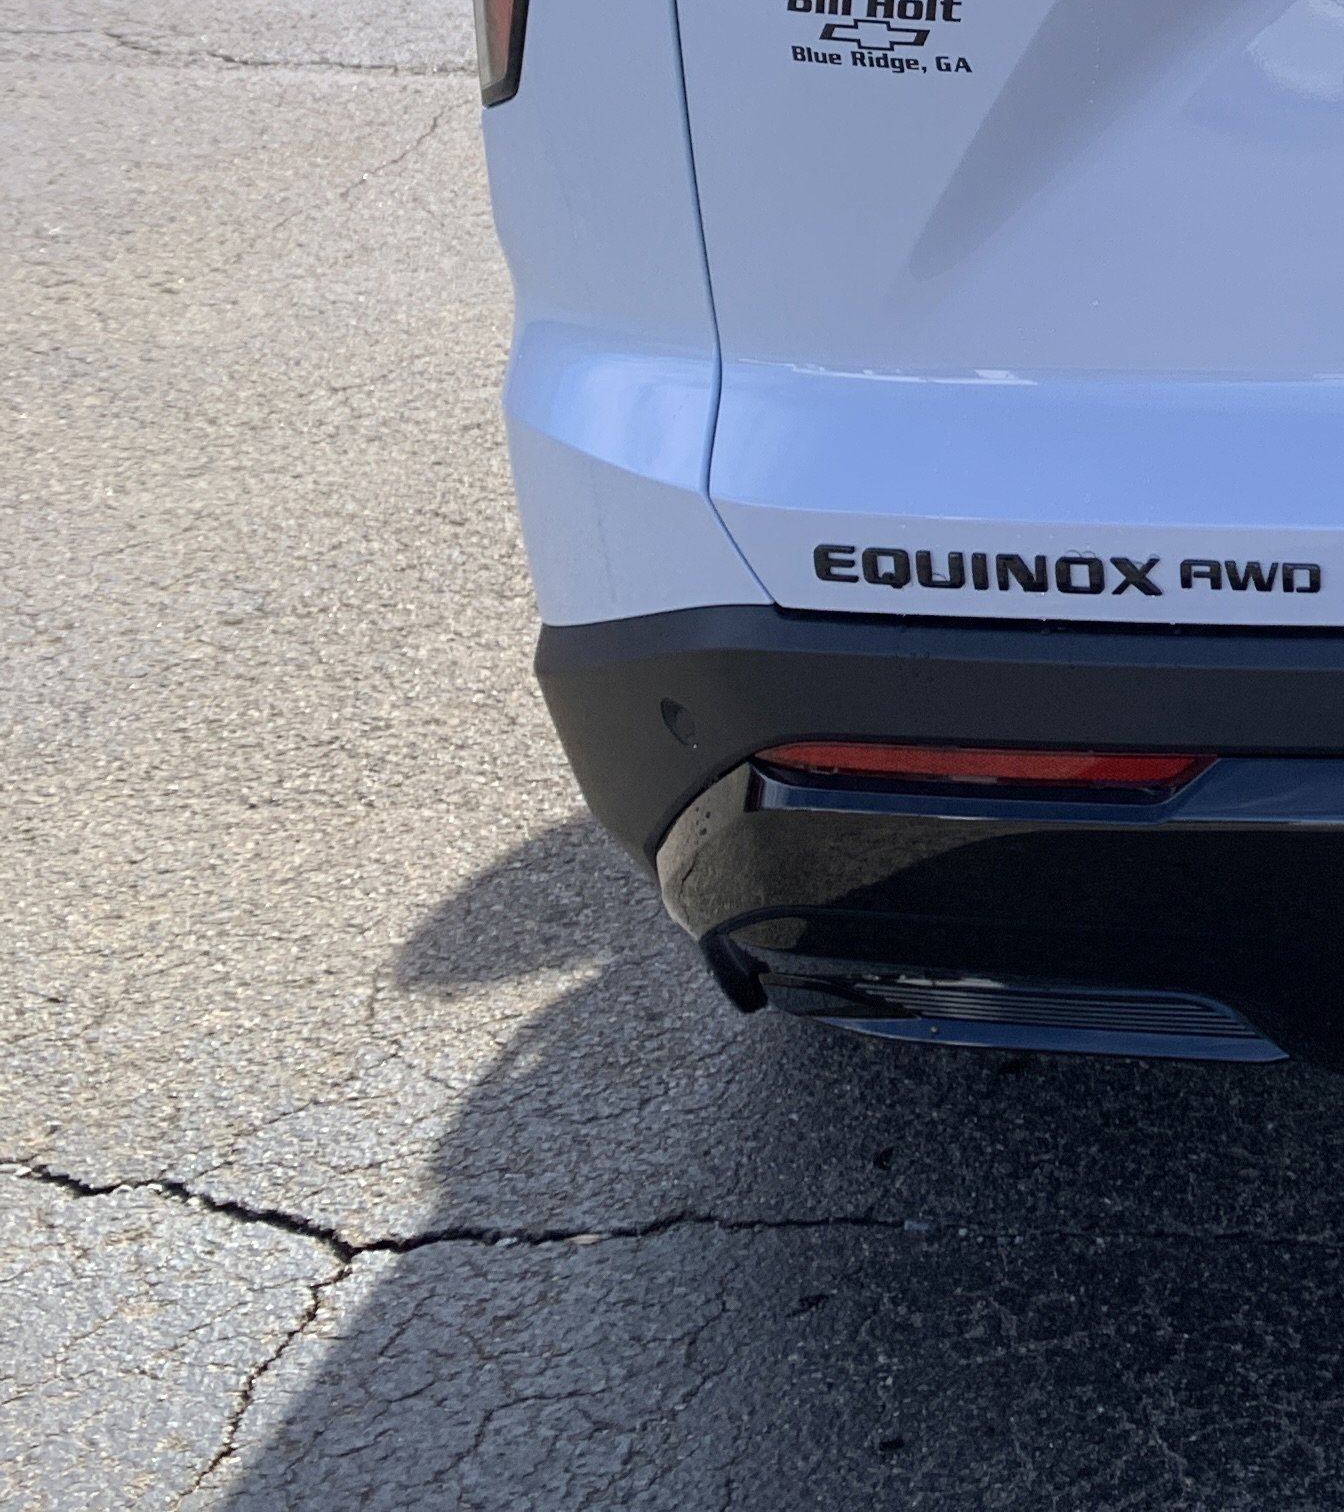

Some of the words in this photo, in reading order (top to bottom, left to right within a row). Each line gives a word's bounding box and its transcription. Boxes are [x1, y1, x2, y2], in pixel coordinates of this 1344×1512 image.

[791, 45, 842, 65] Blue
[850, 51, 927, 74] Ridge,
[935, 56, 973, 73] GA
[813, 544, 1163, 596] EQUINOX
[1179, 558, 1321, 594] AWD
